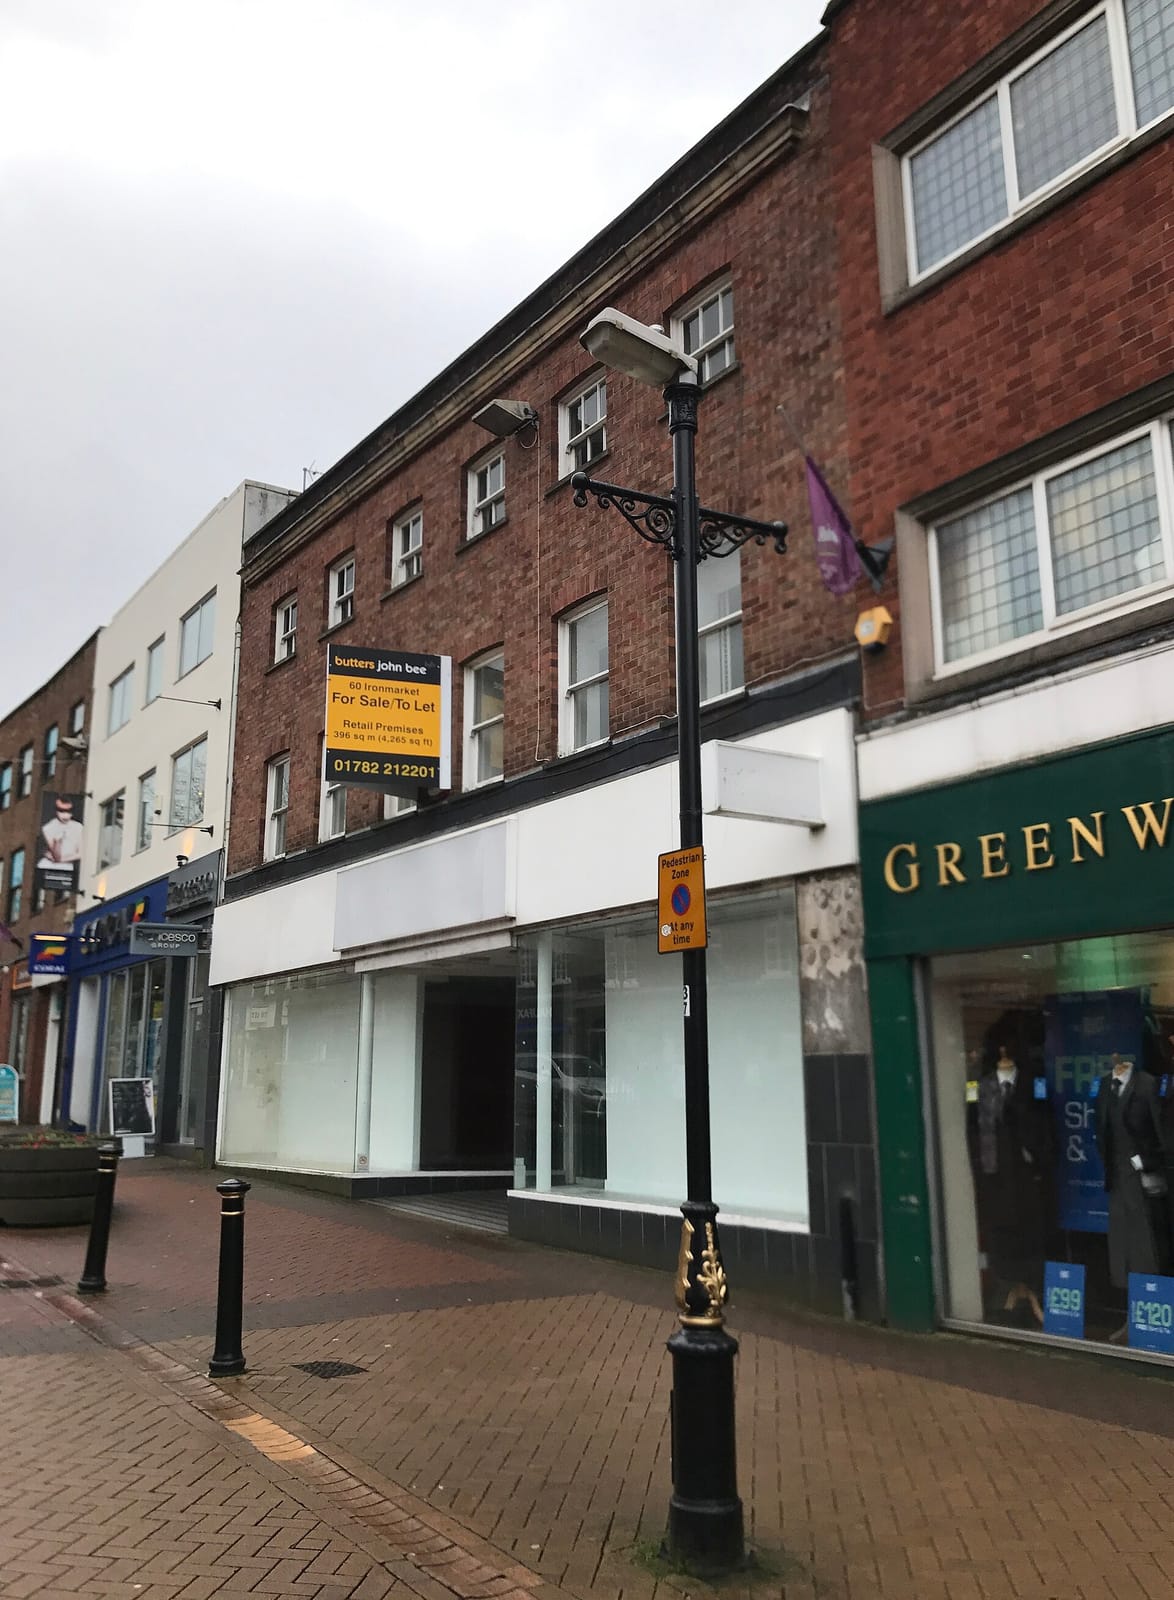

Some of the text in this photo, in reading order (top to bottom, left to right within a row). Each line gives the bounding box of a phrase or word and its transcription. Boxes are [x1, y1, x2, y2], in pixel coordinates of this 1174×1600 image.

[334, 655, 375, 670] butters
[376, 659, 402, 673] john
[405, 663, 427, 675] bee
[349, 681, 420, 696] 60 Ironmarket
[332, 692, 435, 713] For Sale/To Let
[343, 719, 424, 735] Retail Premises
[333, 730, 351, 739] 396
[353, 734, 364, 742] sq
[409, 738, 420, 747] sq
[334, 759, 435, 778] 01782 212201
[883, 797, 1174, 893] GREENW
[661, 853, 700, 869] Pedestrian
[671, 869, 690, 880] Zone
[680, 921, 695, 932] any
[673, 934, 691, 945] time
[1049, 1287, 1081, 1311] £99
[1135, 1300, 1173, 1328] £120
